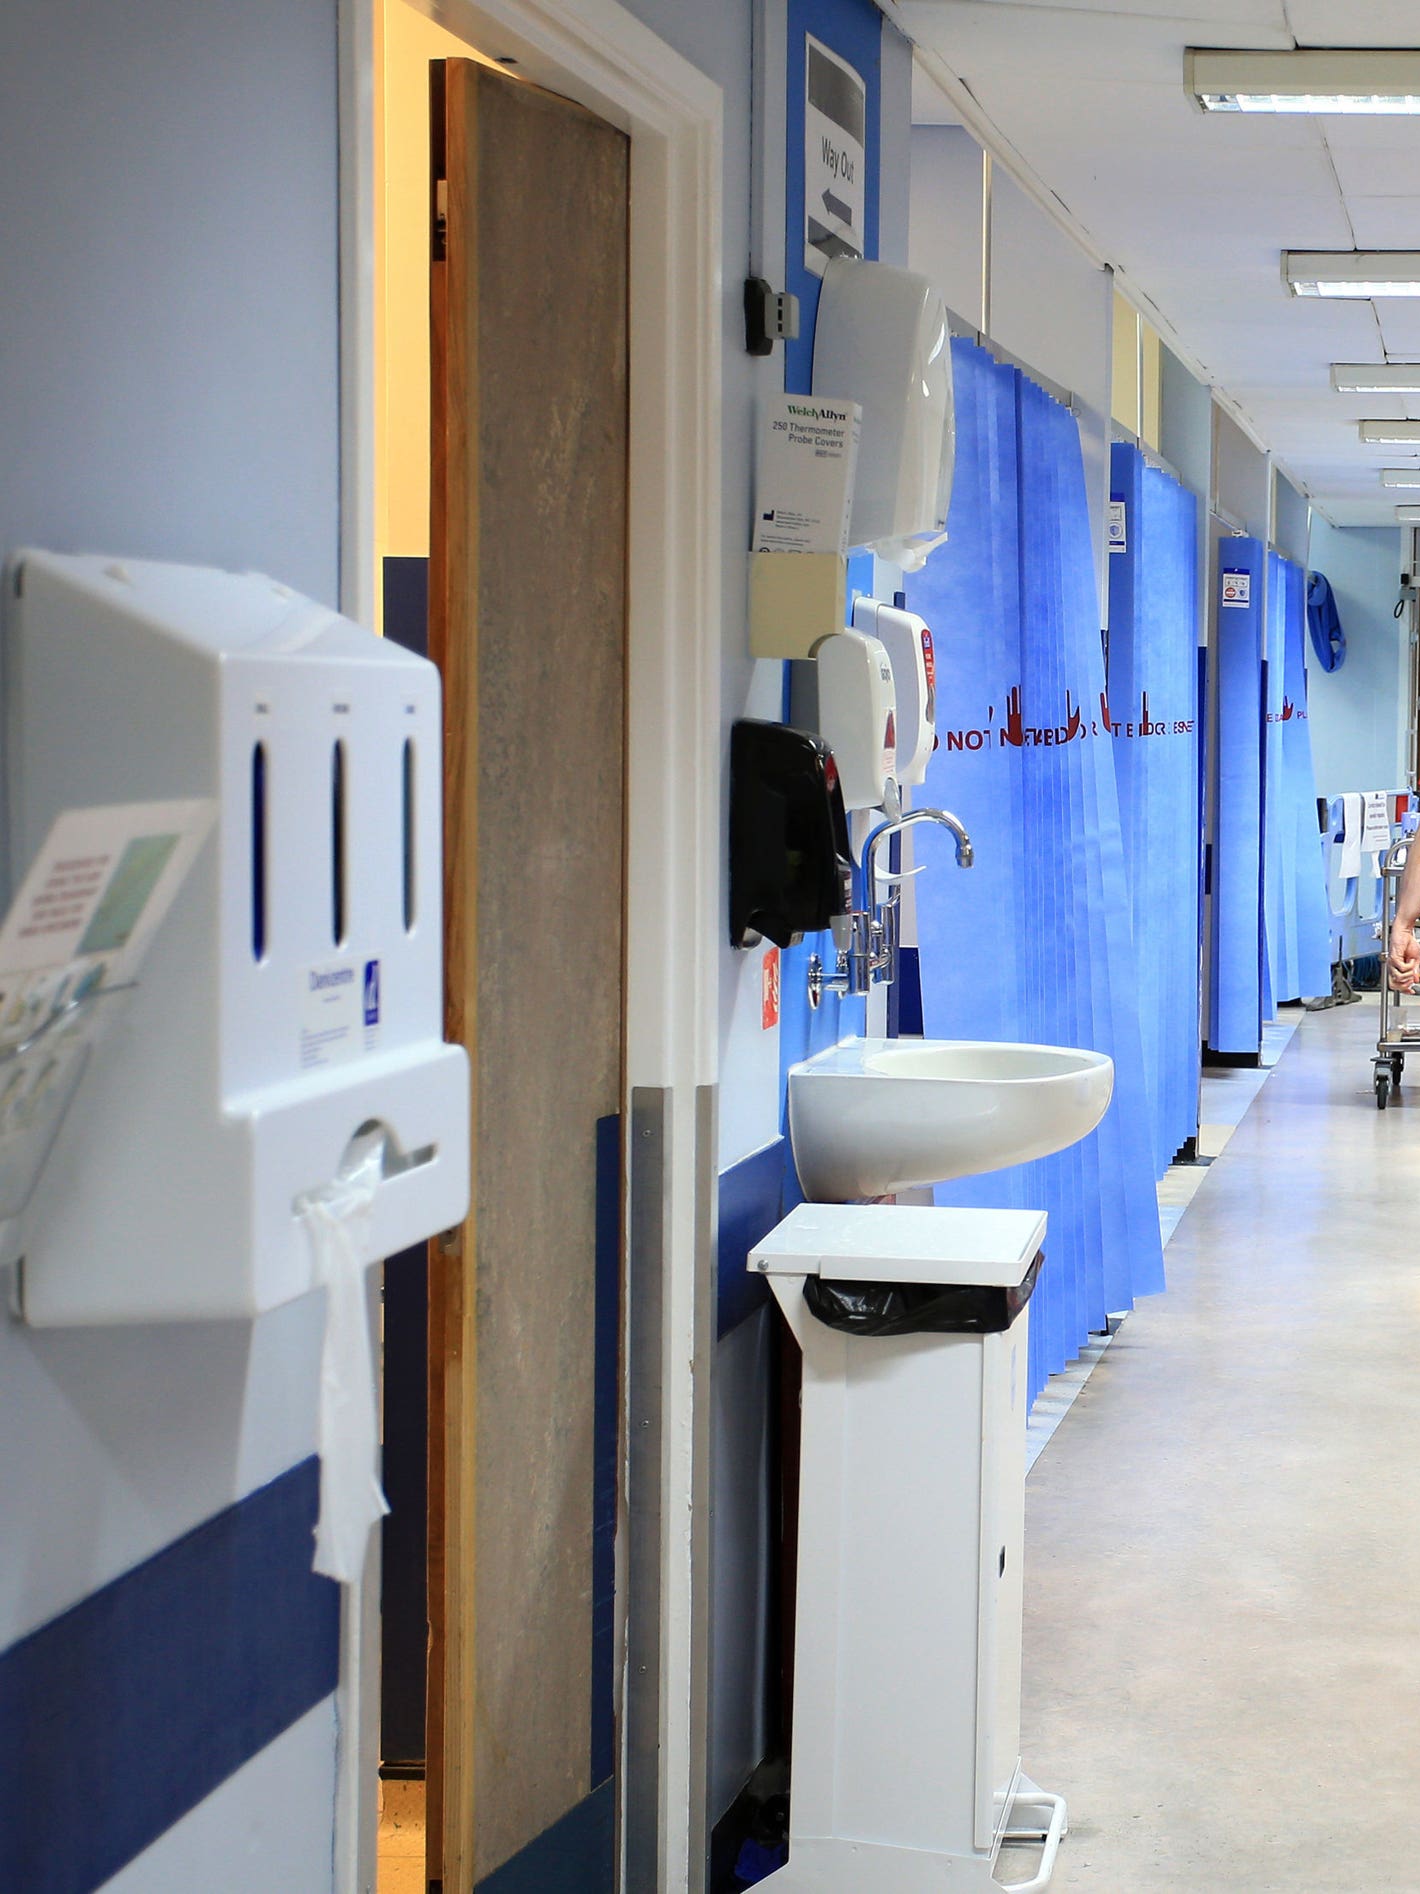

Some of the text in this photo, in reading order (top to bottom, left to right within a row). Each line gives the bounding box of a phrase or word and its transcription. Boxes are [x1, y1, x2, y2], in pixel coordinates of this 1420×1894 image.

[822, 136, 855, 184] Way Out
[773, 421, 788, 431] 250
[790, 422, 845, 438] Thermometer
[788, 433, 844, 449] Probe Covers
